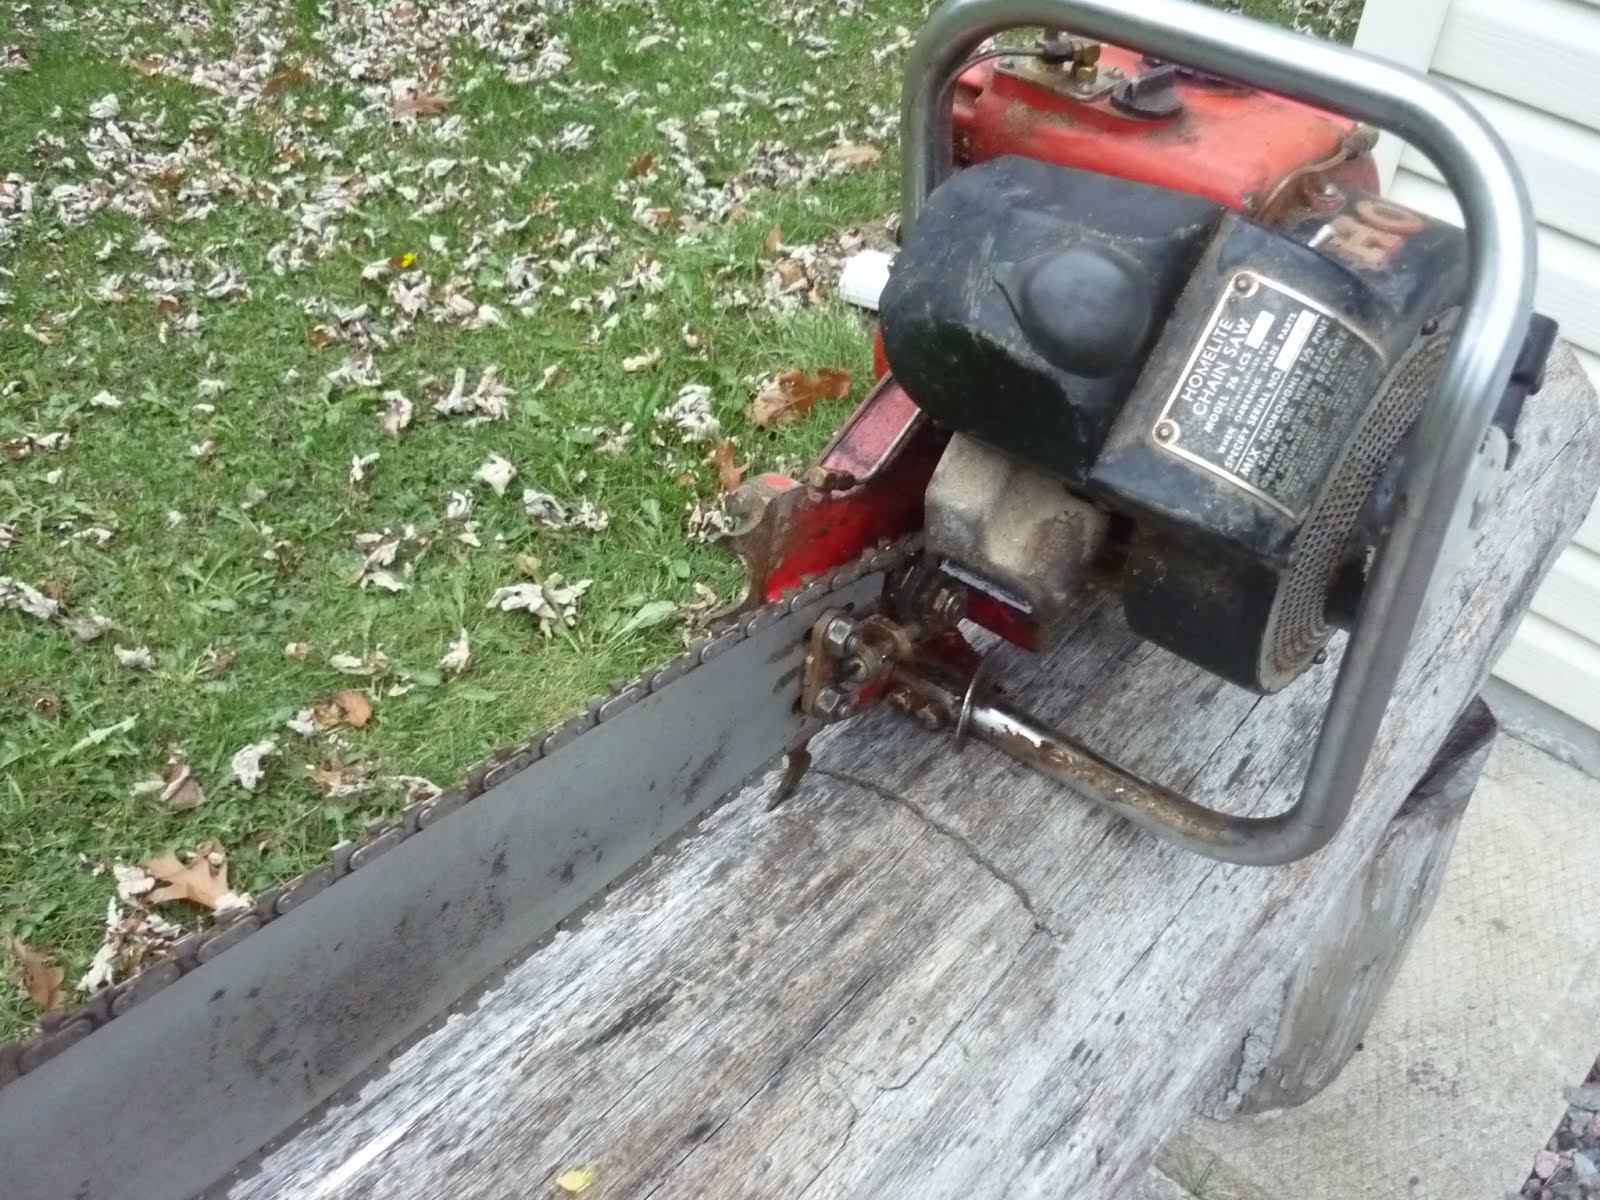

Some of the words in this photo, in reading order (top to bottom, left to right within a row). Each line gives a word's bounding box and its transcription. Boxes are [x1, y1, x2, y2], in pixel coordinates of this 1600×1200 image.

[1181, 316, 1234, 402] HOMELITE
[1190, 358, 1230, 417] CHAIN
[1222, 316, 1251, 358] SAW
[1202, 392, 1230, 433] MODEL
[1225, 374, 1239, 390] 26
[1236, 350, 1252, 371] LCS
[1216, 426, 1236, 454] WHEN
[1233, 376, 1263, 423] ORDERING
[1259, 343, 1280, 372] SPARE
[1277, 311, 1298, 340] PARTS
[1238, 446, 1261, 477] MIX
[1258, 366, 1304, 443] THOROUGHLY
[1310, 317, 1331, 345] PINT
[1280, 404, 1296, 425] OIL
[1292, 371, 1313, 402] WITH
[1309, 339, 1331, 369] EACH
[1314, 329, 1349, 383] BEFORE
[1223, 426, 1251, 468] SPECIFY
[1246, 390, 1271, 426] SERIAL
